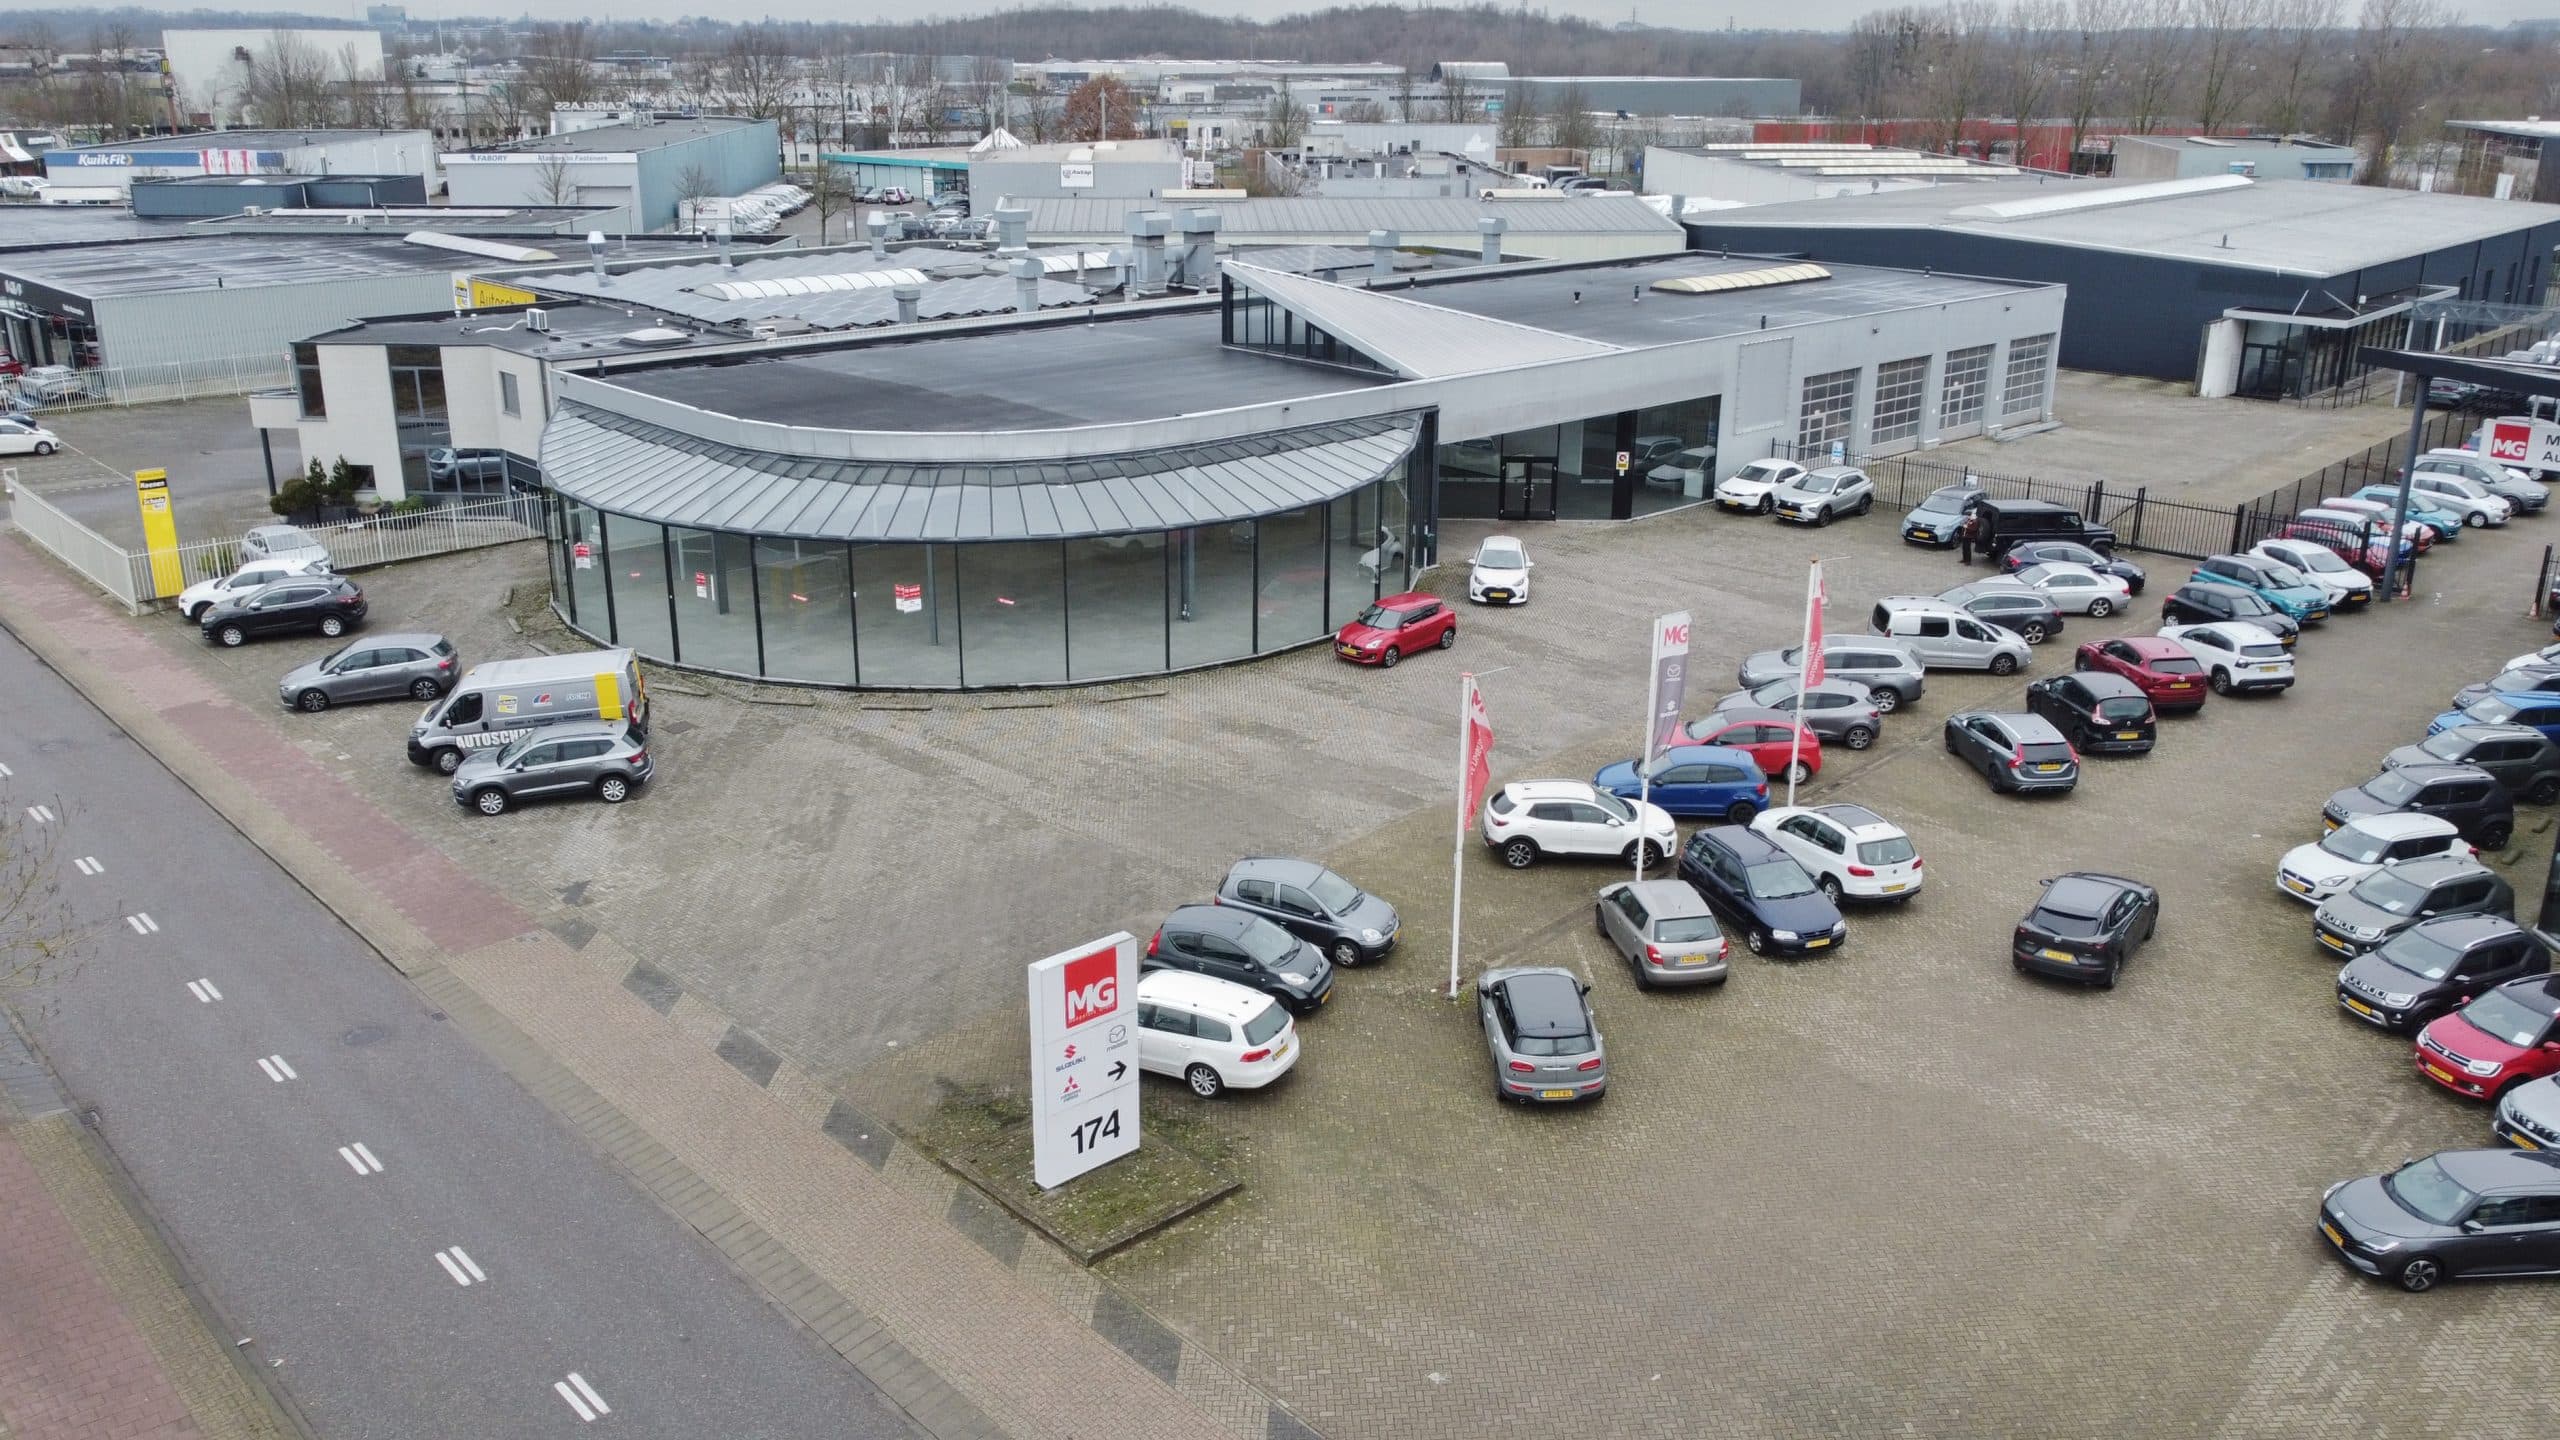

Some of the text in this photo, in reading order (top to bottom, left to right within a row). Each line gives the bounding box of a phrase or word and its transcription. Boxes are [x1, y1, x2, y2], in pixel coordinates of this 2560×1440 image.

[2493, 439, 2527, 457] MG
[1664, 624, 1688, 646] MG
[1067, 976, 1115, 1020] MG
[1056, 1056, 1086, 1072] SUZUKI
[1070, 1109, 1121, 1154] 174
